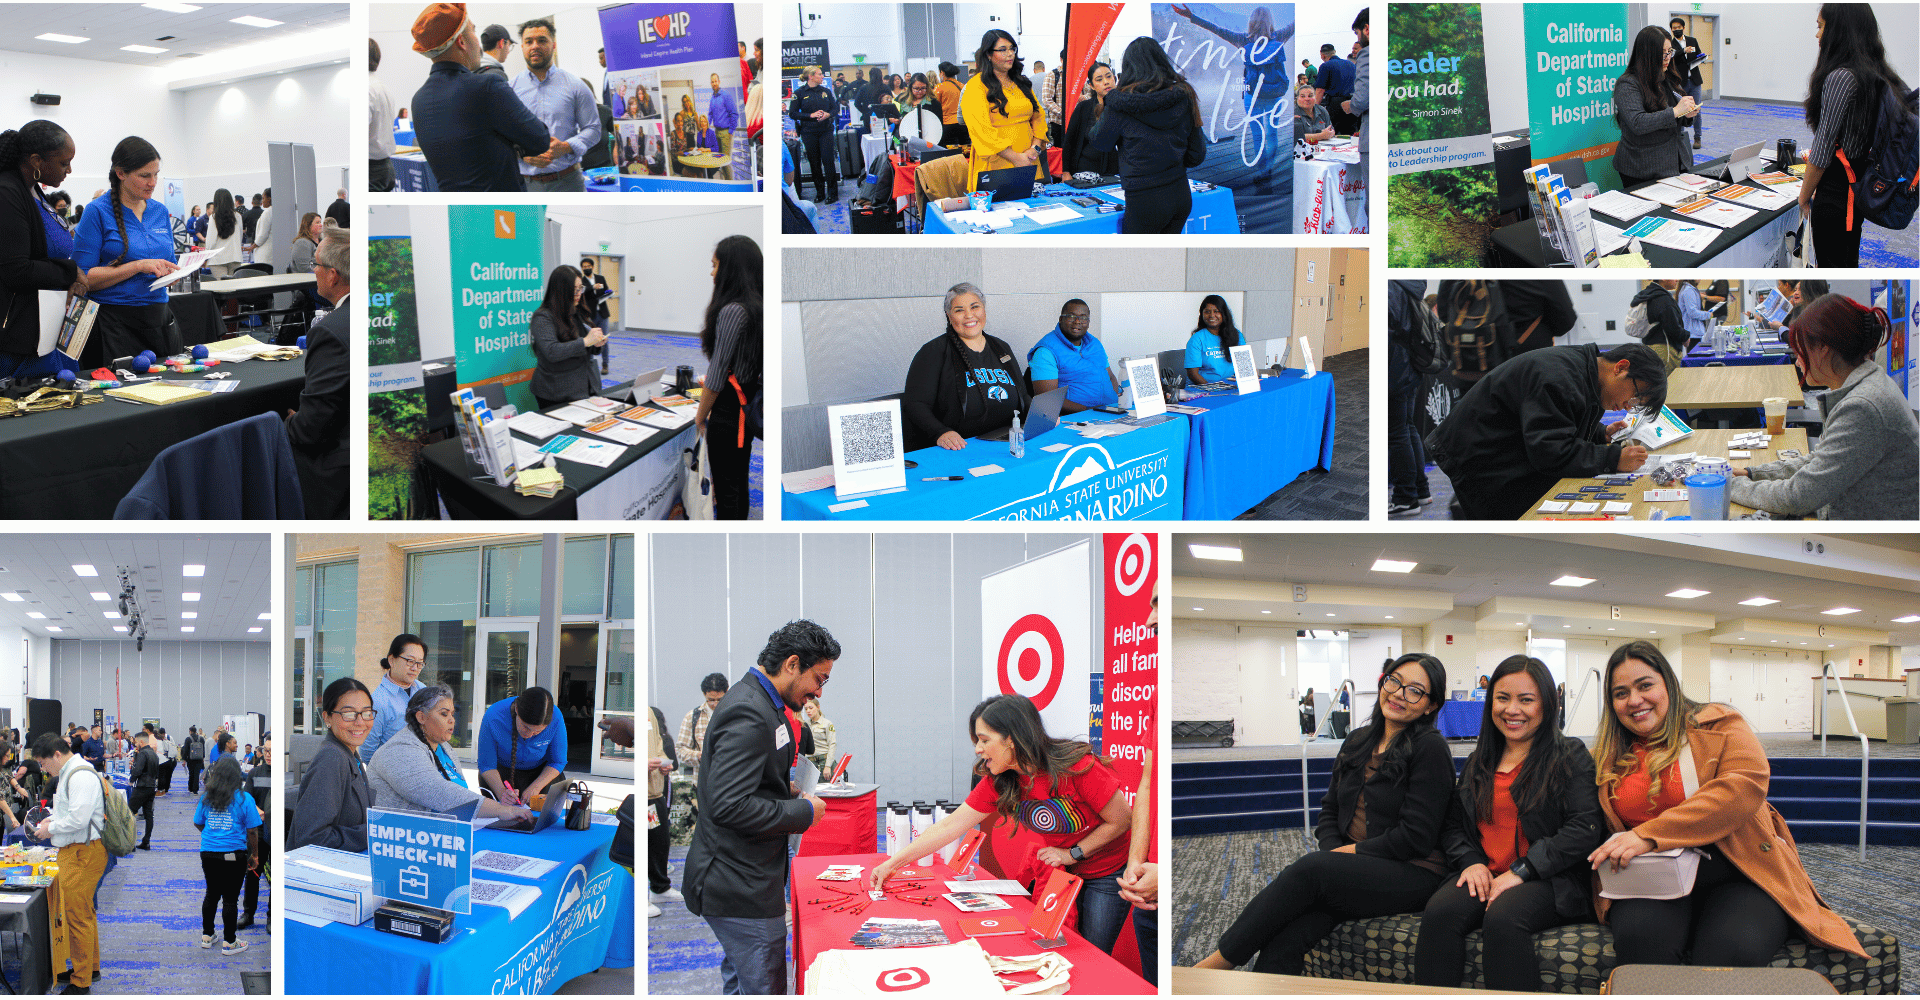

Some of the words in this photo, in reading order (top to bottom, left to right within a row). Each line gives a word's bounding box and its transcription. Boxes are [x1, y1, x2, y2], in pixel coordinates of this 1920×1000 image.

[1546, 22, 1623, 44] California
[781, 47, 822, 57] NAHEIM
[1159, 22, 1285, 73] time
[783, 56, 817, 65] POLICE
[1537, 48, 1629, 75] Department
[1424, 78, 1463, 97] had.
[1556, 76, 1572, 98] of
[1576, 75, 1617, 95] State
[1210, 70, 1294, 167] life
[1412, 109, 1440, 118] Simon
[1441, 106, 1463, 116] Sinek
[1388, 148, 1404, 158] Ask
[1405, 146, 1432, 156] about
[1433, 144, 1449, 153] our
[1388, 159, 1398, 168] to
[1400, 154, 1448, 167] Leadership
[1448, 151, 1487, 163] program.
[470, 261, 540, 281] California
[462, 286, 544, 309] Department
[479, 310, 493, 329] of
[498, 308, 534, 327] State
[376, 336, 396, 345] Sinek
[383, 376, 418, 387] program.
[997, 500, 1060, 520] ORNIA
[1065, 481, 1101, 508] STATE
[1105, 455, 1169, 490] UNIVERSITY
[1059, 474, 1168, 520] NARDINO
[1292, 585, 1307, 602] B
[1610, 605, 1621, 620] B
[1112, 652, 1128, 675] all
[1111, 710, 1133, 731] the
[368, 823, 466, 852] EMPLOYER
[371, 841, 457, 868] CHECK-IN
